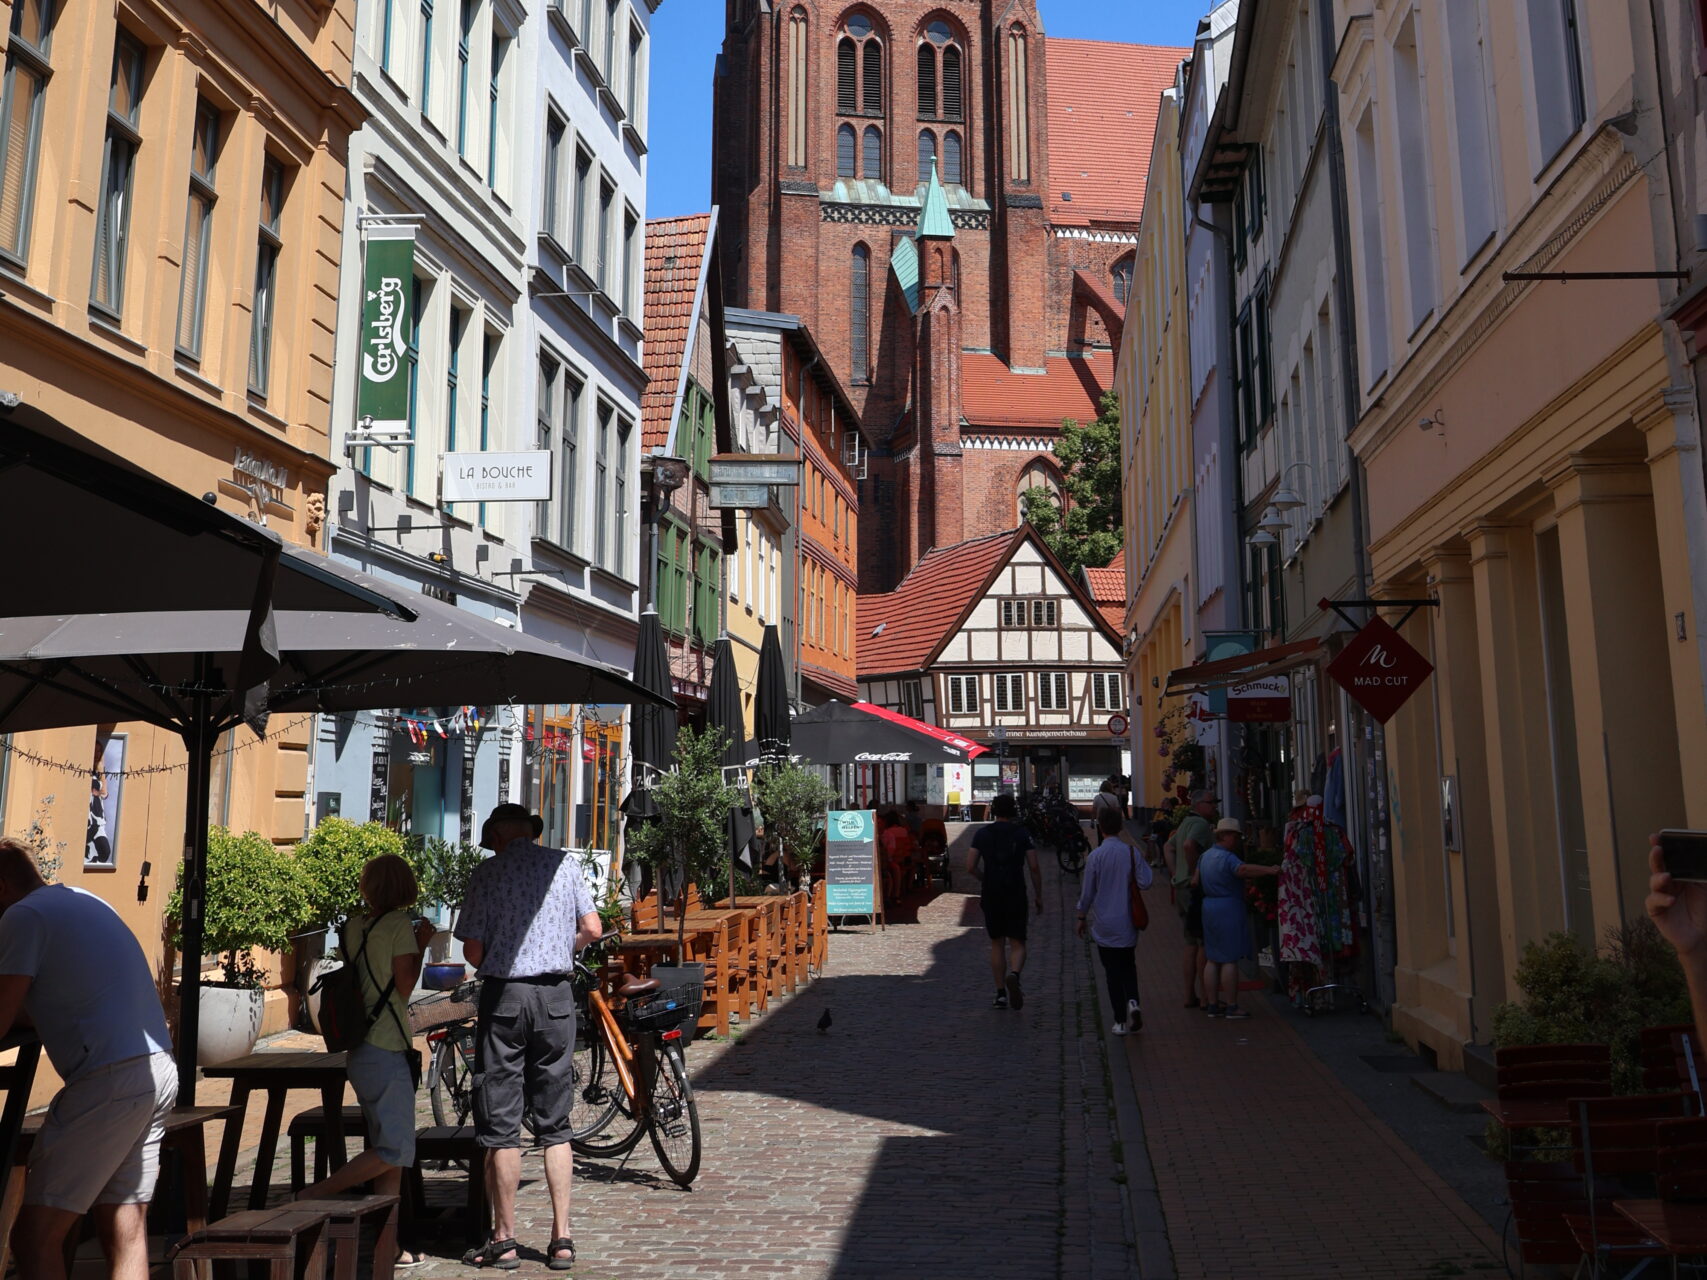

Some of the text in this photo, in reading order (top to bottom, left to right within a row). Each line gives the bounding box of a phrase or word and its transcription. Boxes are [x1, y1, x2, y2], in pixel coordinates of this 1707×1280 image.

[362, 276, 407, 383] Carlsberg
[459, 465, 533, 480] LA BOUCHE
[1354, 676, 1409, 686] MAD CUT
[854, 752, 913, 762] Coca-Cola
